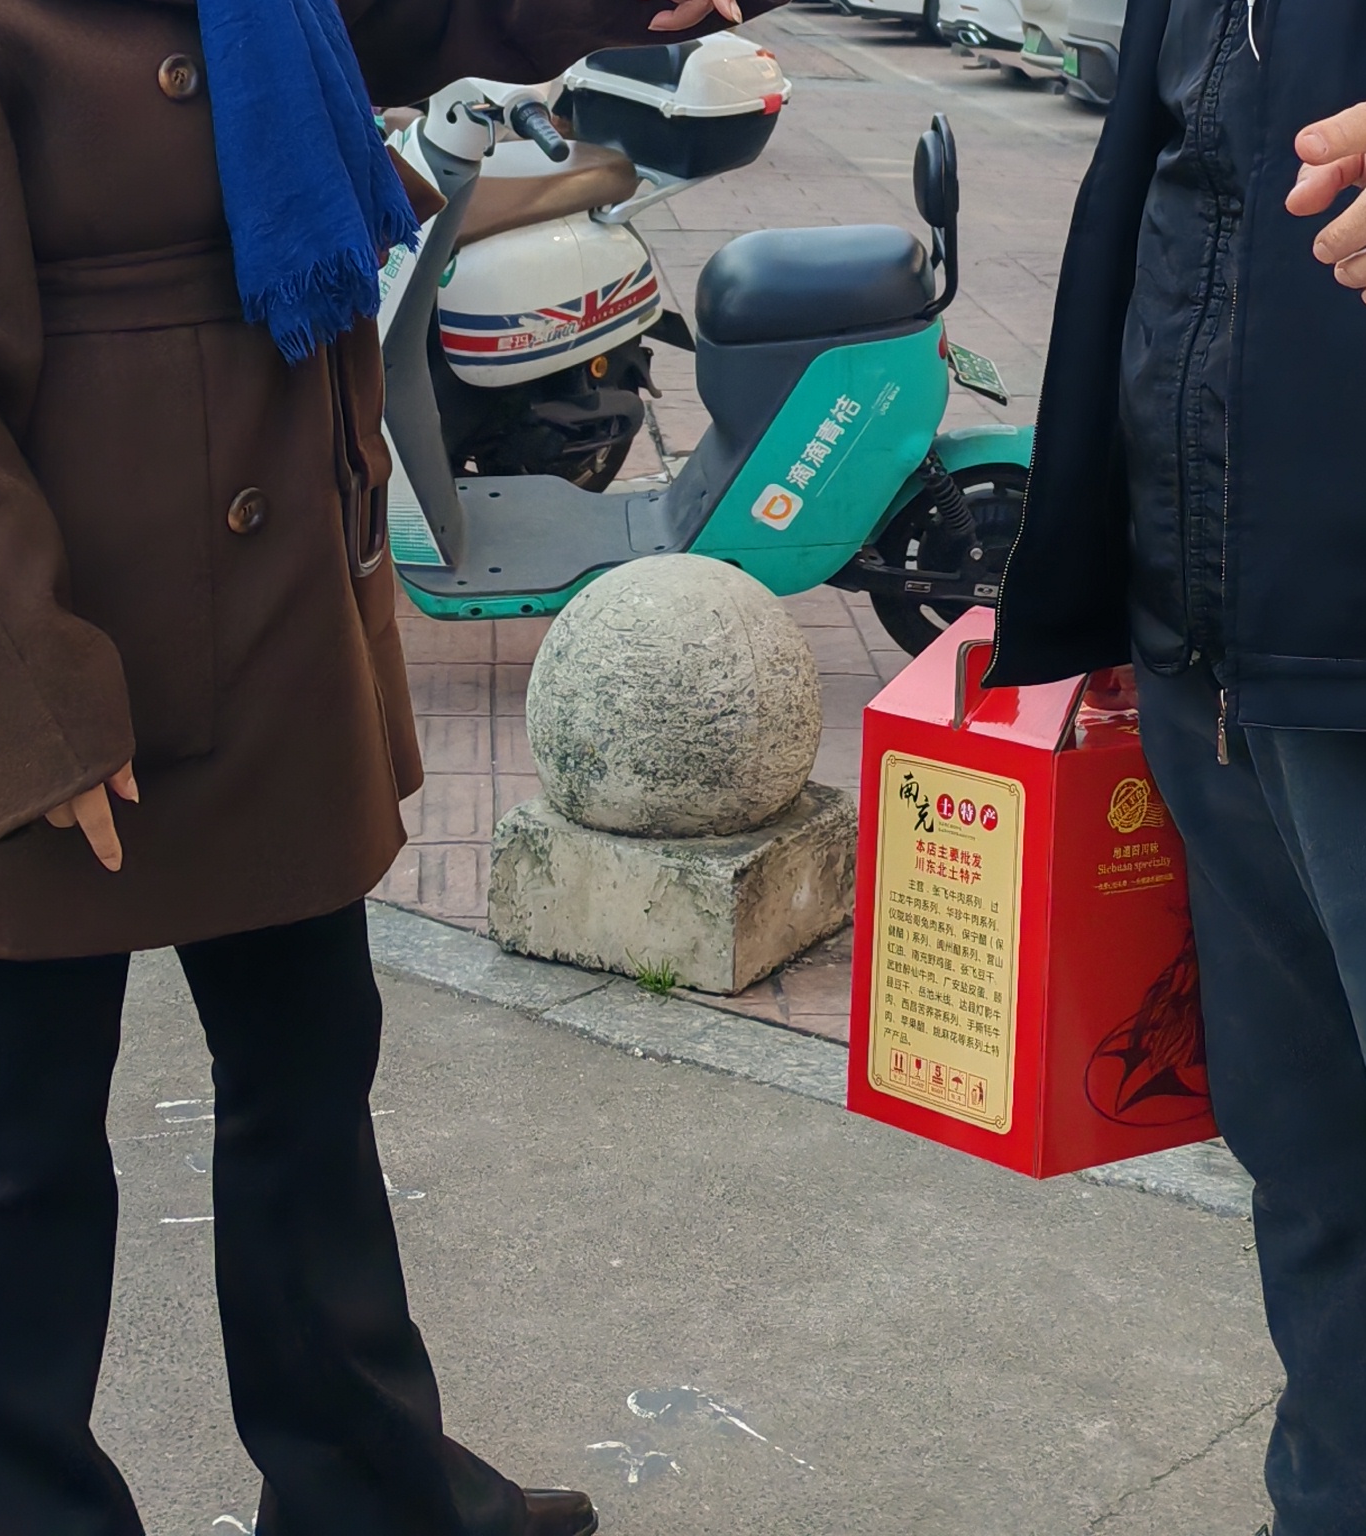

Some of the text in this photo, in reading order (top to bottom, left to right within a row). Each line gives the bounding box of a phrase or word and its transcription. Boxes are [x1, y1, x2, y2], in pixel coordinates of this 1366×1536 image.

[786, 394, 861, 490] 滴滴青桔
[915, 838, 983, 870] 本店主要批发
[915, 855, 982, 886] 川东北土特产
